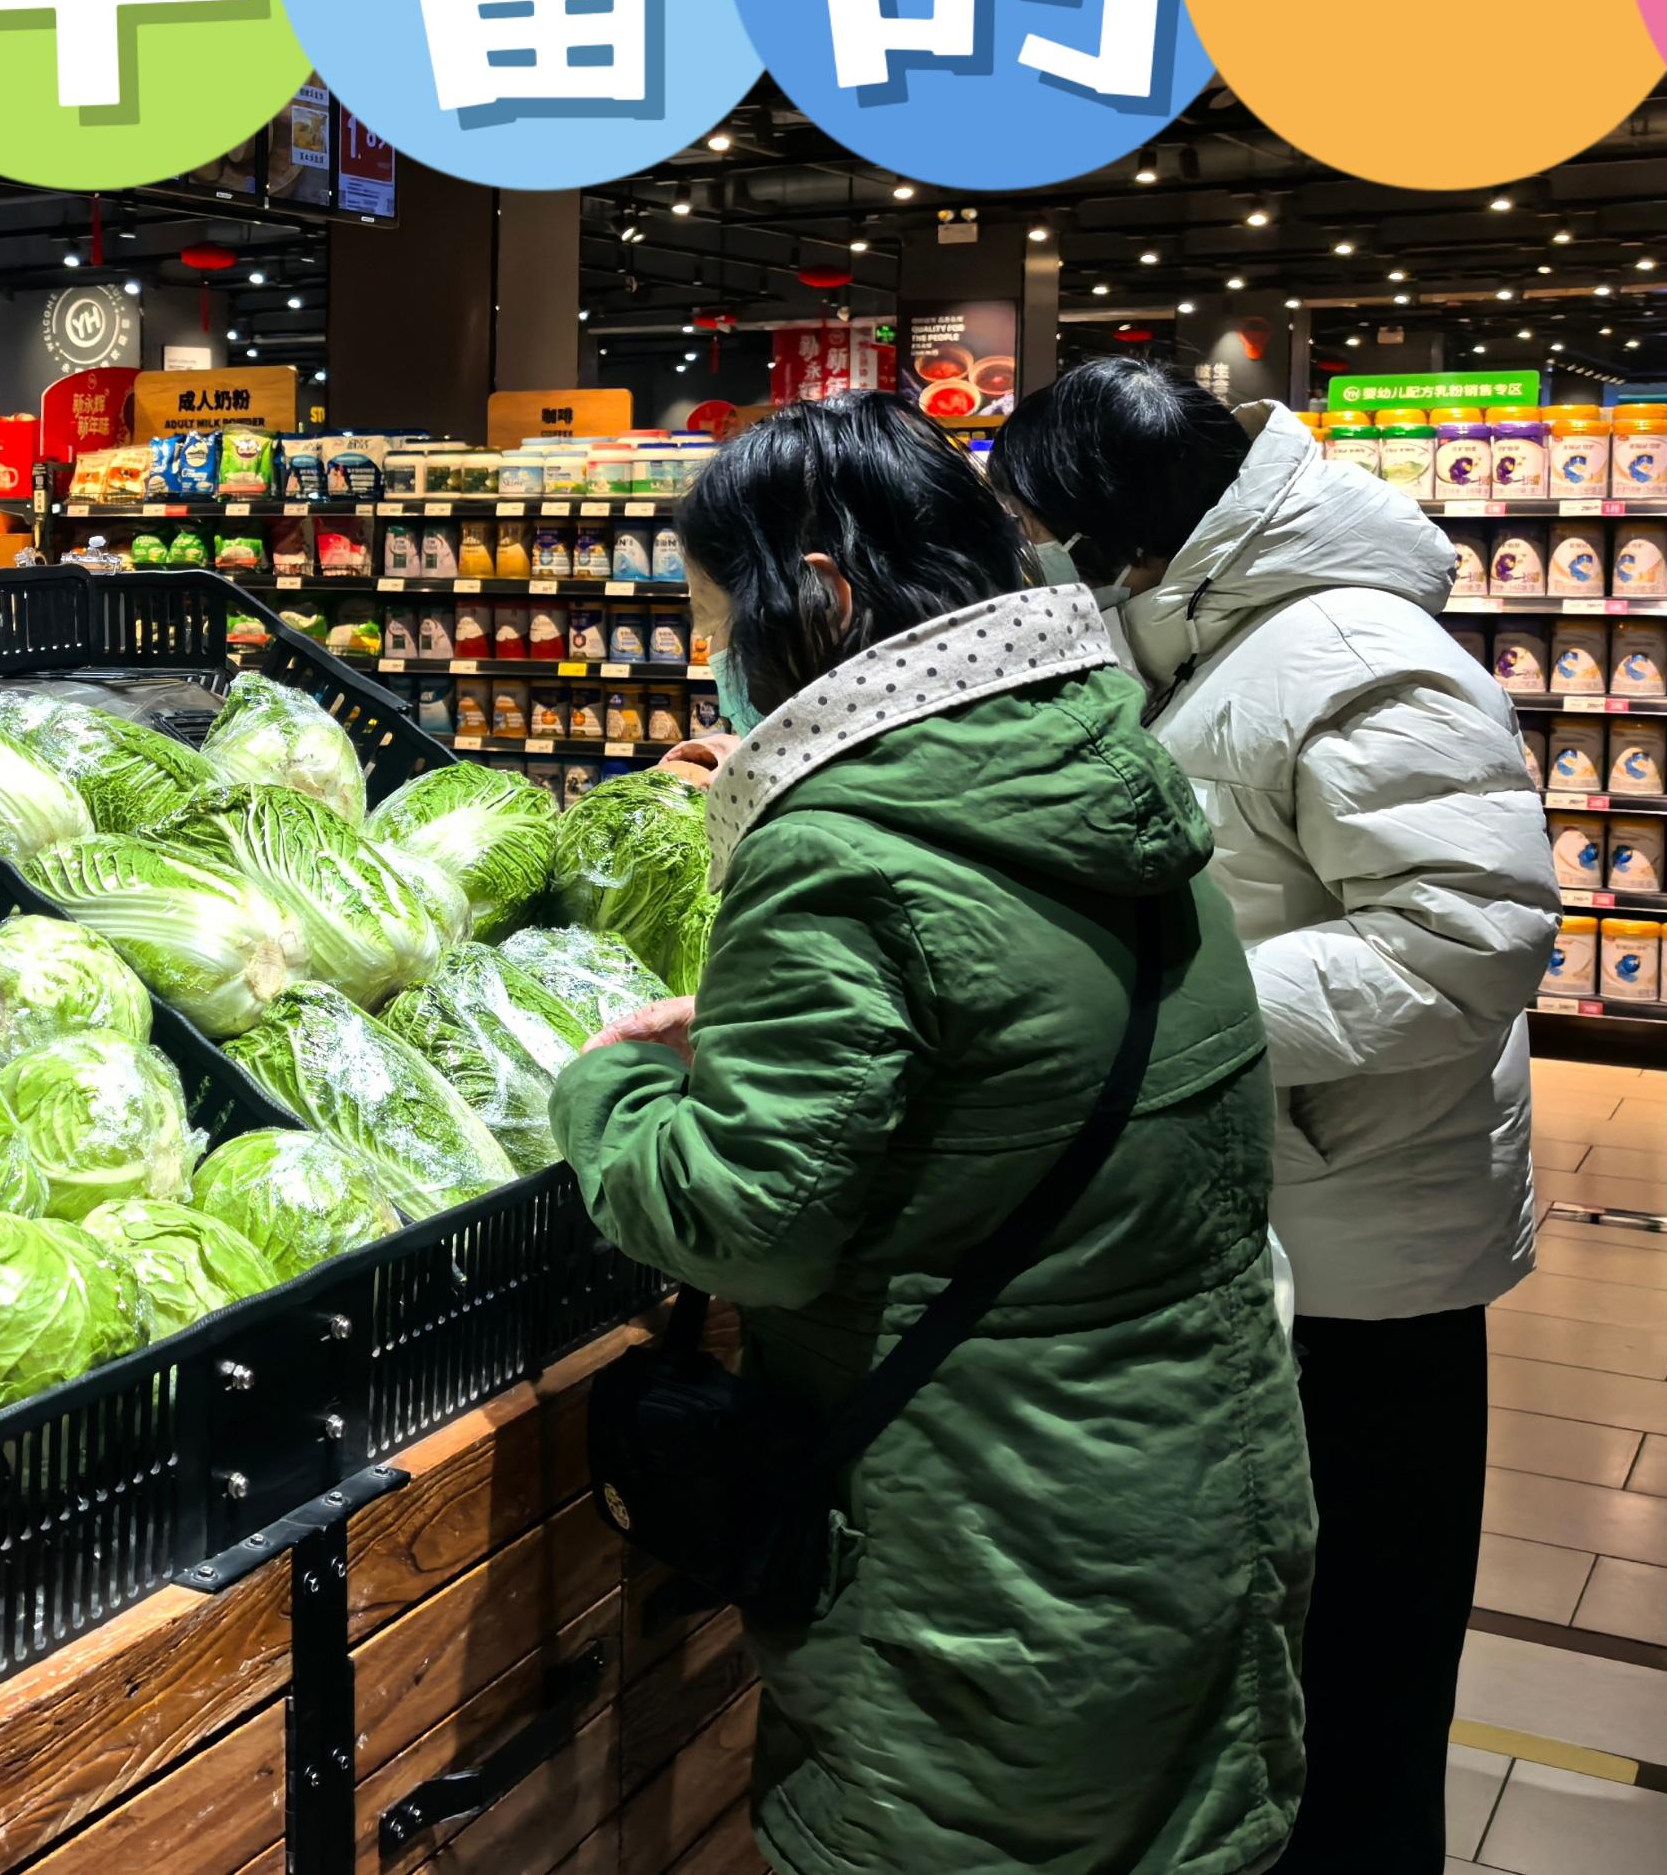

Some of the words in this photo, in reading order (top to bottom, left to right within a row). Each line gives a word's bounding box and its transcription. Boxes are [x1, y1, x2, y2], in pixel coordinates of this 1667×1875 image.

[1363, 382, 1523, 400] 婴幼儿配方乳粉销售专区
[178, 388, 251, 413] 成人奶粉
[165, 417, 195, 430] ADULT
